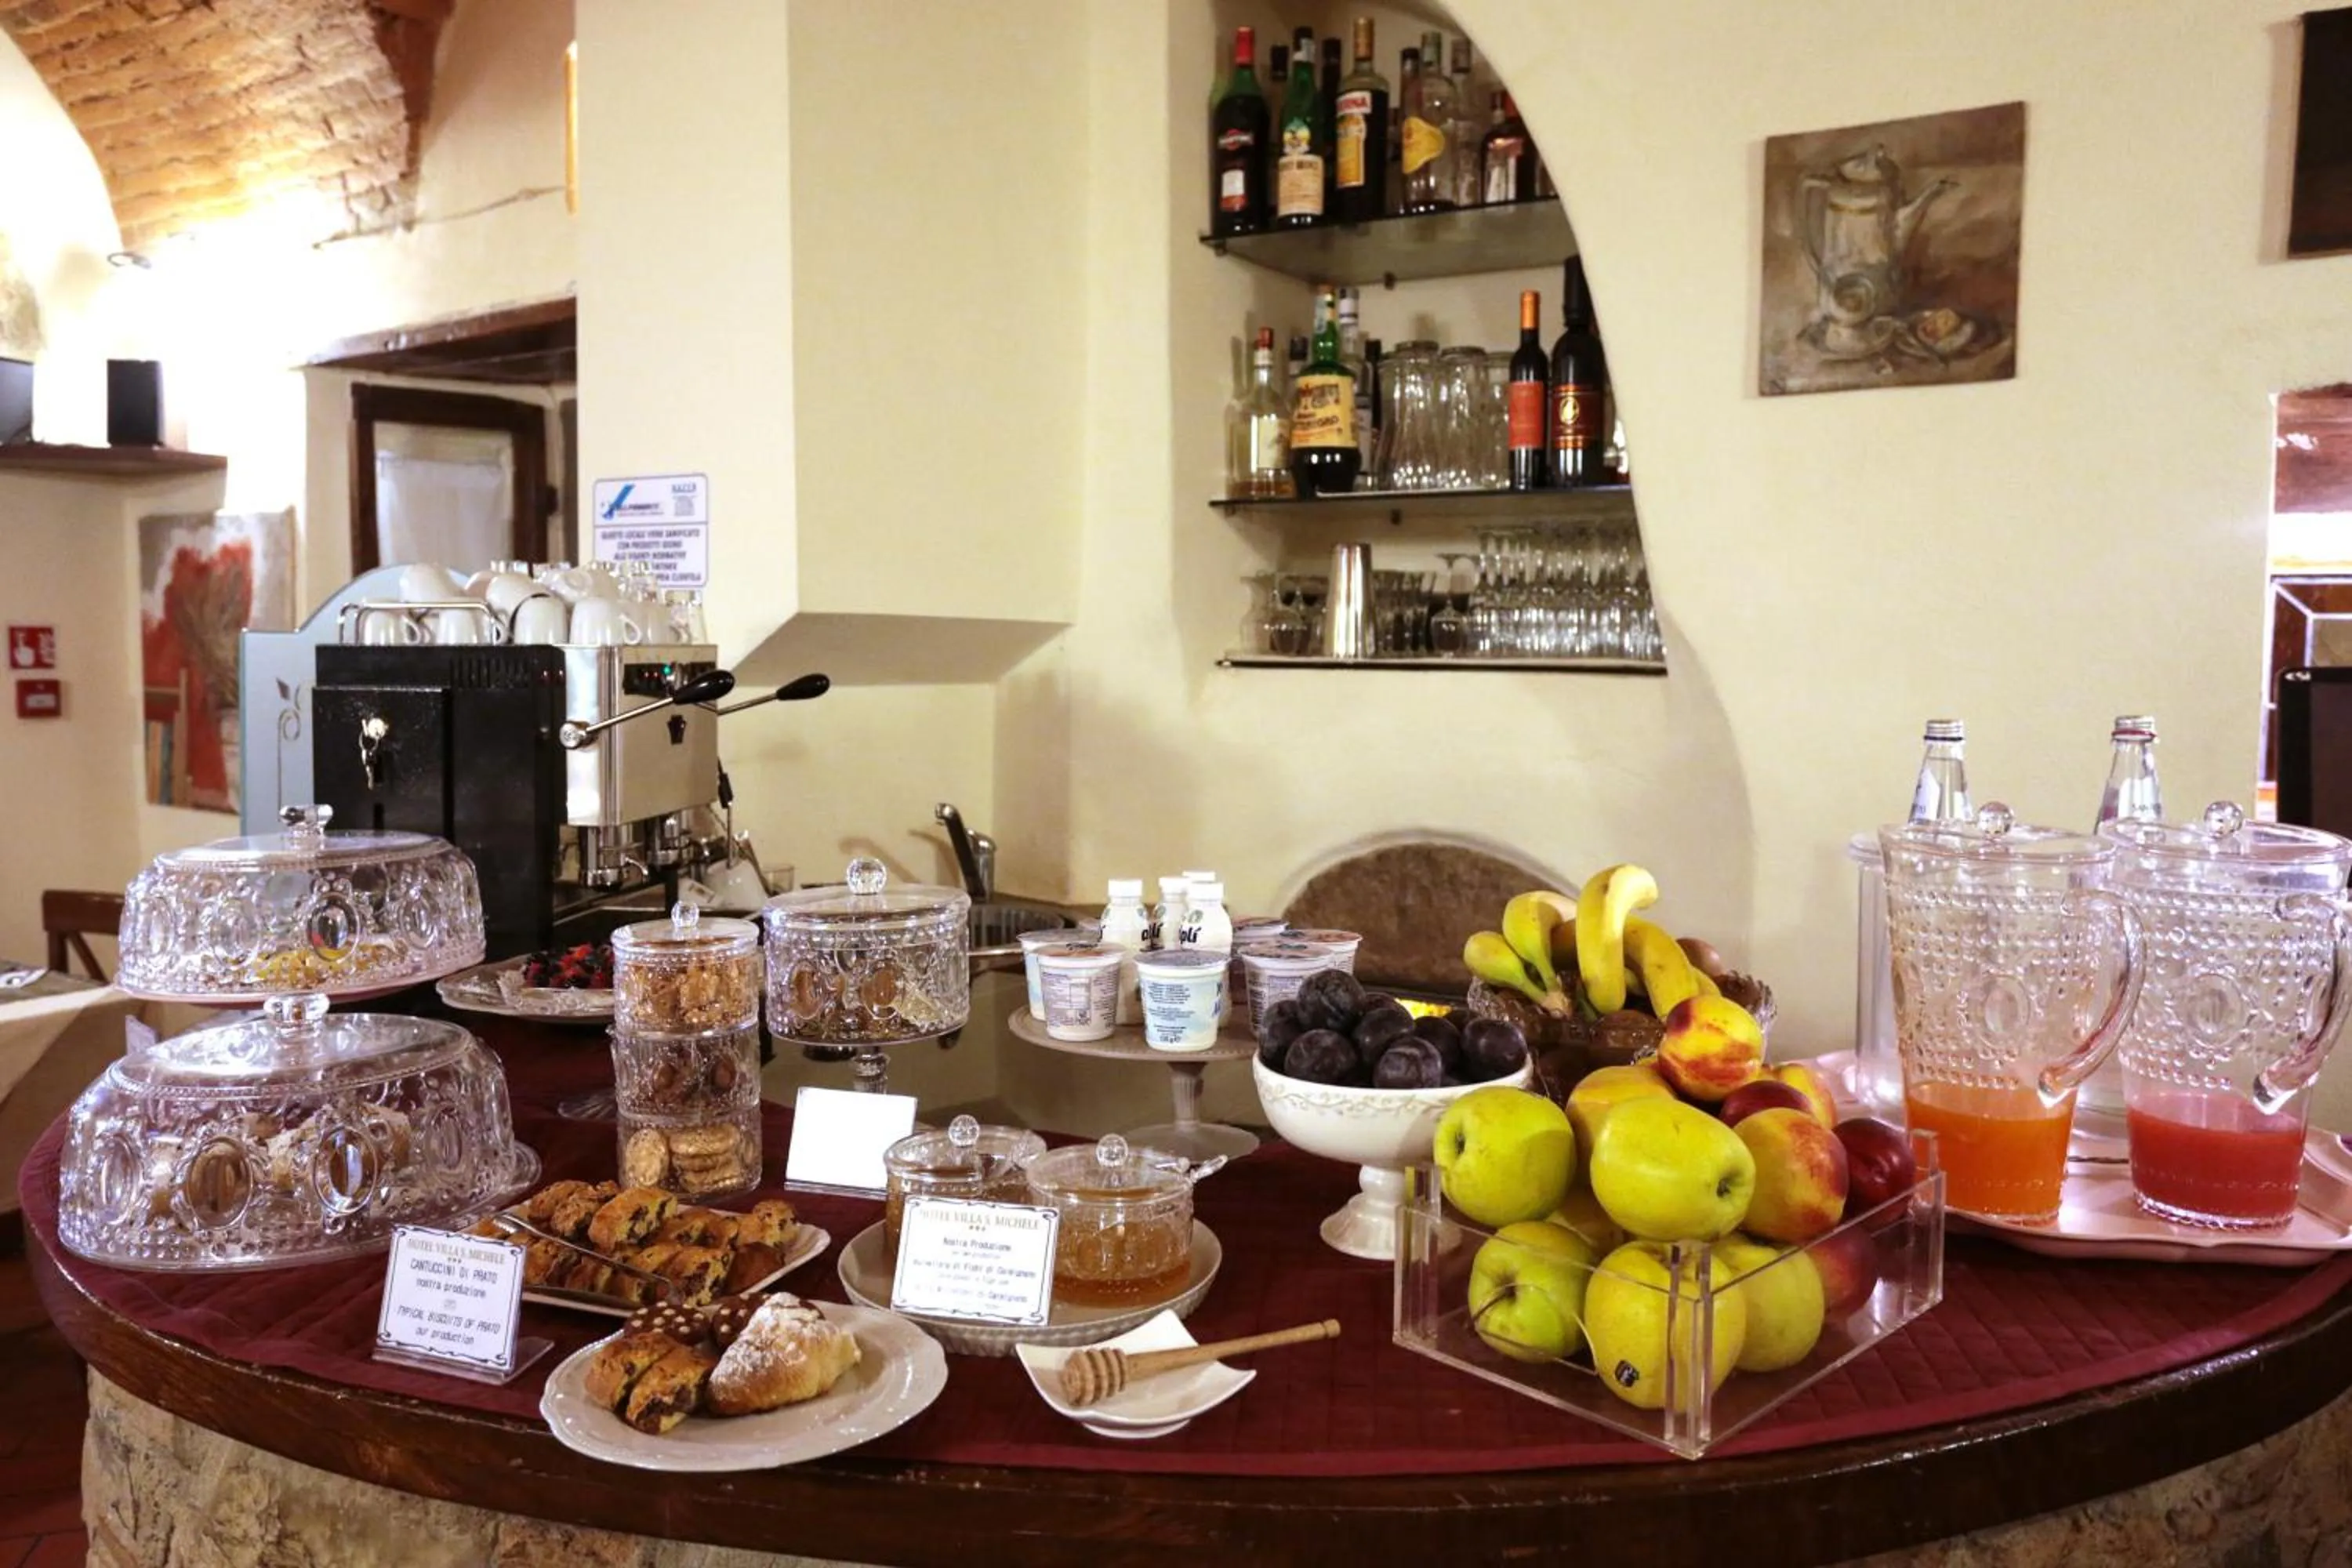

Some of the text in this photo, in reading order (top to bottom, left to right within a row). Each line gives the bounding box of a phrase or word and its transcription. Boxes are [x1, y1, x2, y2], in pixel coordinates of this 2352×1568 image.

[953, 1211, 982, 1224] VILLA
[995, 1216, 1040, 1230] MICHELE
[410, 1258, 456, 1276] CANTUCCINI
[473, 1269, 499, 1285] PRATO
[416, 1278, 486, 1298] nostra produzione
[427, 1311, 463, 1327] BISCUITS
[477, 1319, 501, 1334] PRATO
[430, 1328, 474, 1345] production
